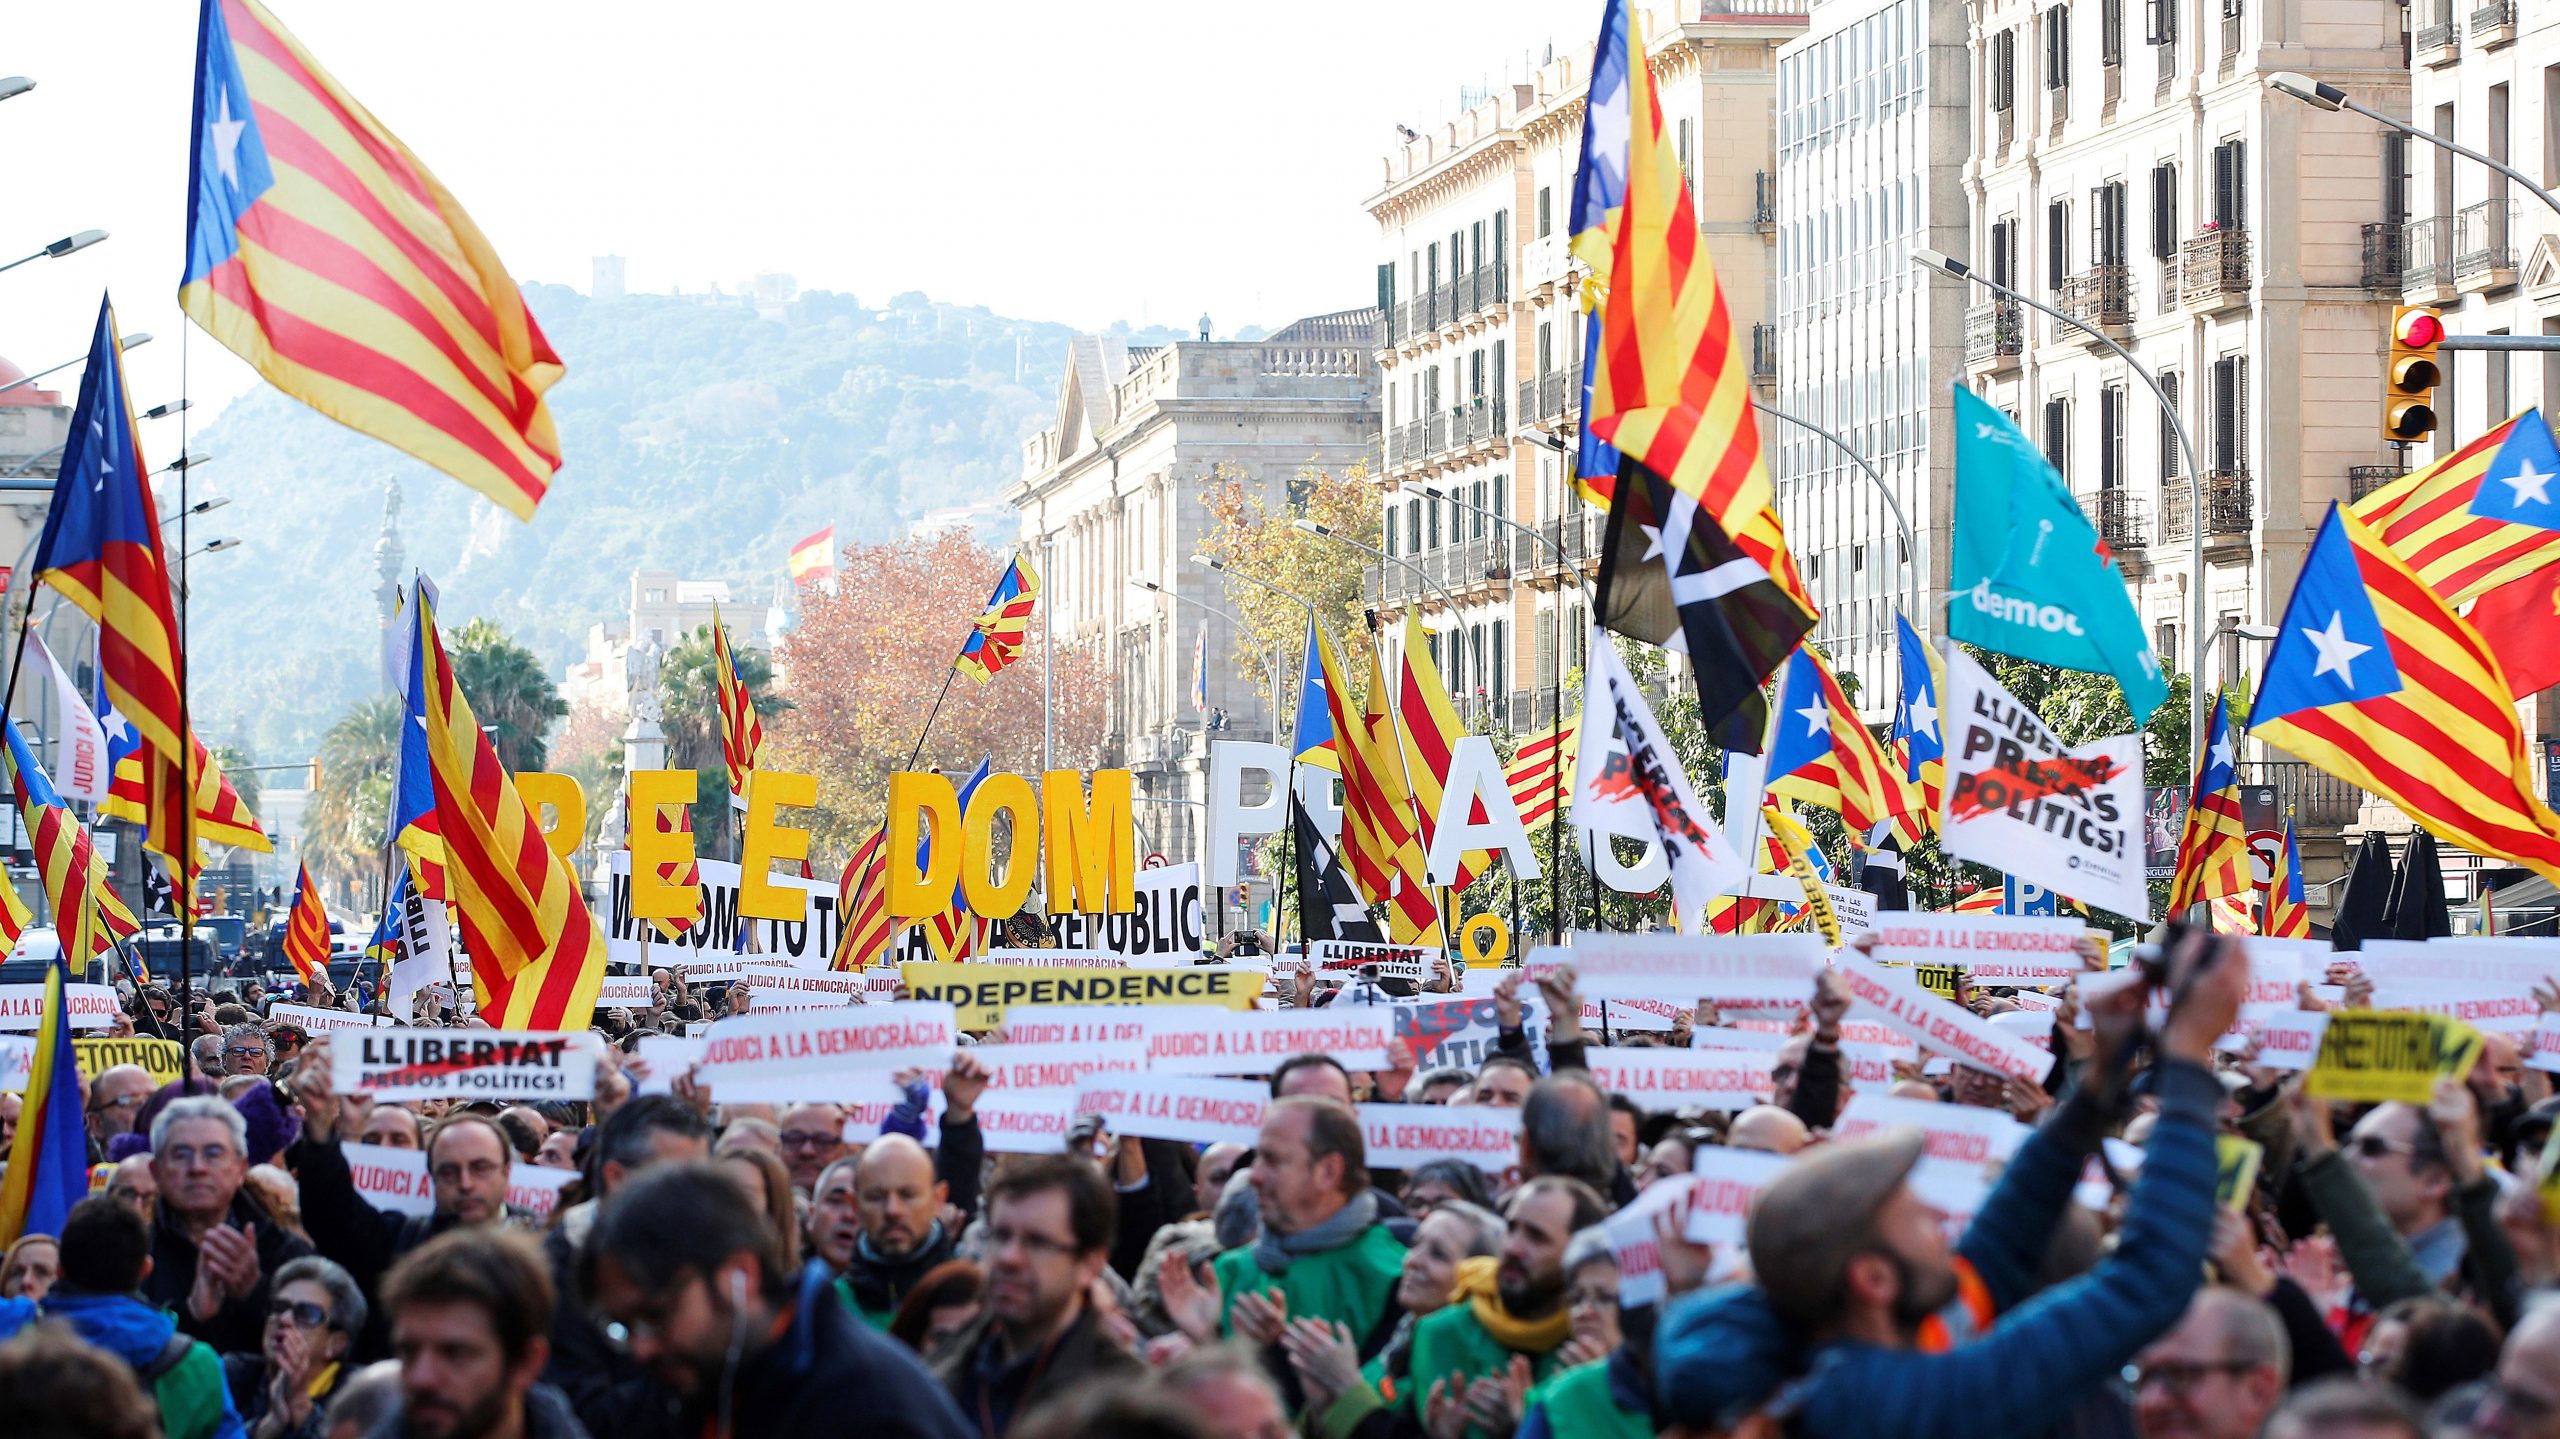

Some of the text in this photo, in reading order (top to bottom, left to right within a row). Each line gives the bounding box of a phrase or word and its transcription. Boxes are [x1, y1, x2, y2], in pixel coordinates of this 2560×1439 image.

[74, 740, 96, 794] JUDICI
[514, 768, 1135, 922] REEDOM
[1880, 926, 1931, 948] JUDICI
[1934, 928, 1945, 947] A
[1950, 928, 1970, 949] LA
[1322, 943, 1424, 965] LLIBERTAT
[687, 964, 714, 975] JUDICI
[716, 964, 722, 974] A
[724, 963, 735, 973] LA
[1275, 961, 1300, 972] JUDIC
[1321, 960, 1423, 976] PRESO OLÍTICS!
[746, 974, 778, 989] JUDICI
[779, 978, 785, 989] A
[787, 977, 800, 990] LA
[865, 978, 899, 992] JUDIC
[914, 971, 1231, 1008] NDEPENDENCE
[14, 998, 31, 1017] LA
[35, 993, 118, 1017] DOCRÀCIA
[1890, 997, 1904, 1016] A
[1905, 1004, 1929, 1031] LA
[363, 1037, 567, 1068] LLIBERTAT
[701, 1016, 949, 1066] JUDICI A LA DEMOCRÀCIA
[1148, 1034, 1208, 1057] JUDICI
[1214, 1033, 1226, 1055] A
[1232, 1031, 1253, 1055] LA
[361, 1070, 566, 1091] PRESOS POLÍTICS!
[1617, 1066, 1631, 1090] A
[1635, 1066, 1658, 1091] LA
[1130, 1090, 1141, 1116] A
[1147, 1092, 1169, 1118] LA
[1369, 1126, 1392, 1150] LA
[417, 1174, 431, 1198] A
